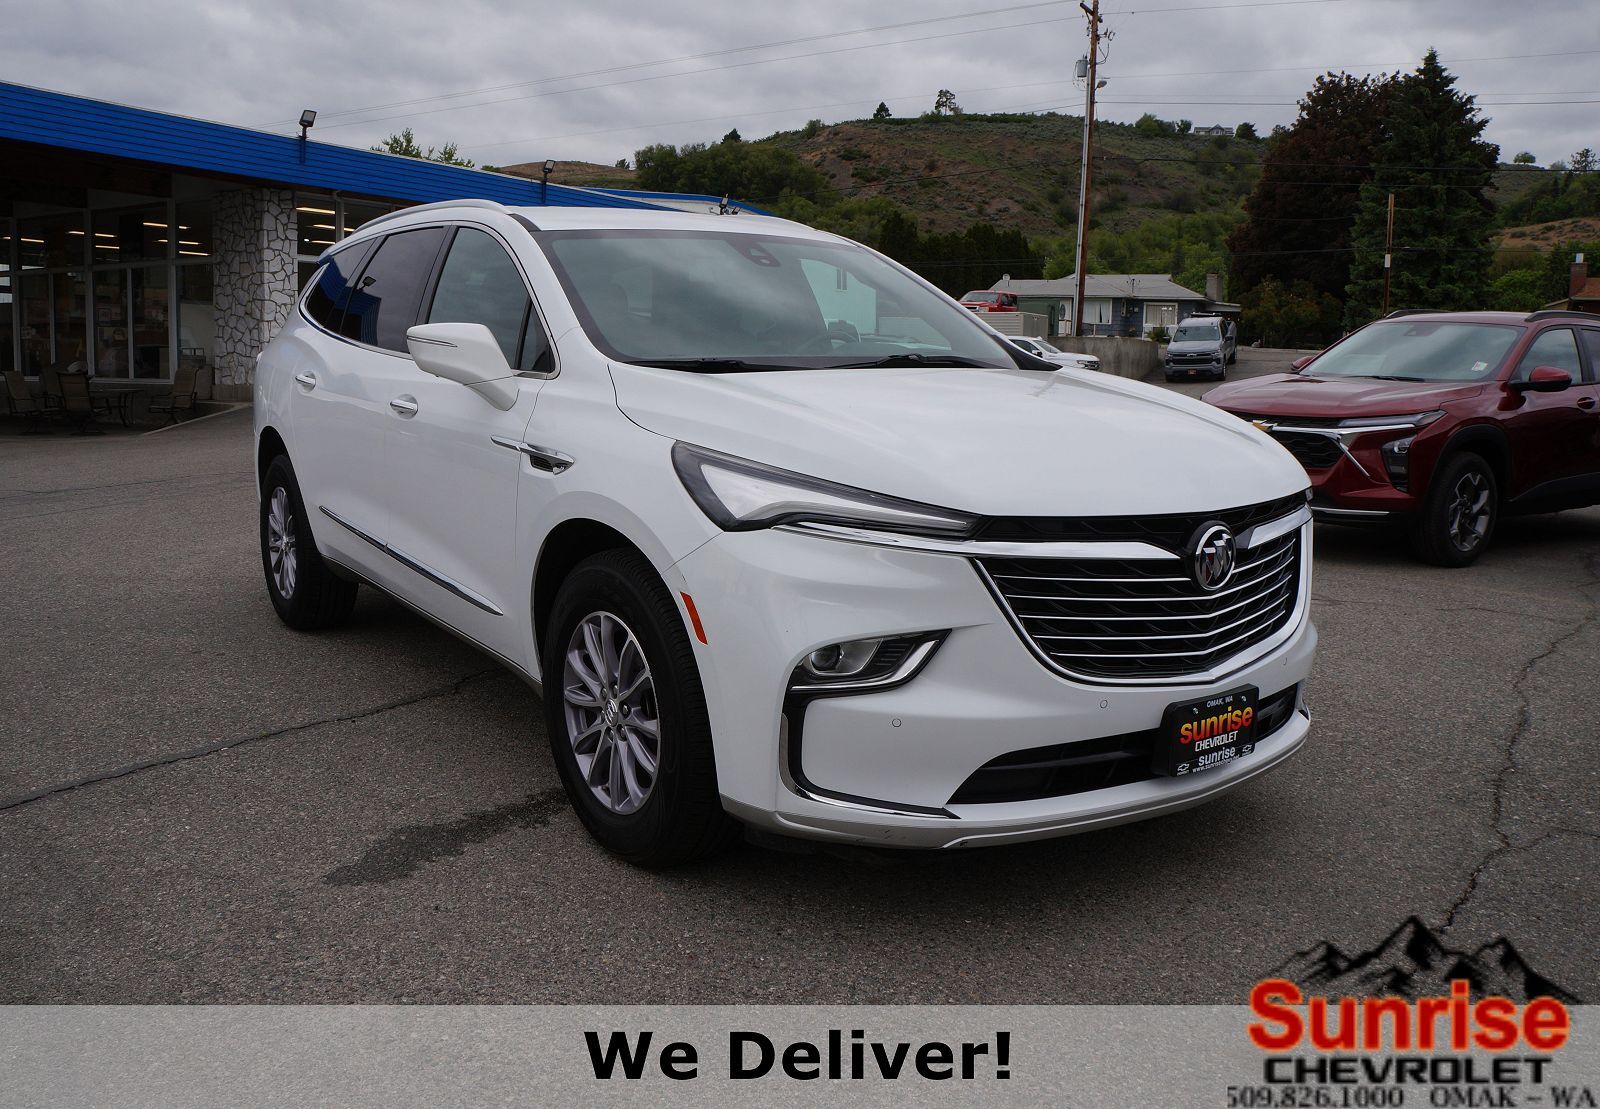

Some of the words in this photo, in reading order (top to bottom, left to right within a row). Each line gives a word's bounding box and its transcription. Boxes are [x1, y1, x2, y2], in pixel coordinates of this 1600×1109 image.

[1225, 695, 1233, 704] WA
[1180, 706, 1253, 744] sunrise
[1195, 730, 1238, 752] CHEVROLET
[1198, 746, 1236, 767] sunrise
